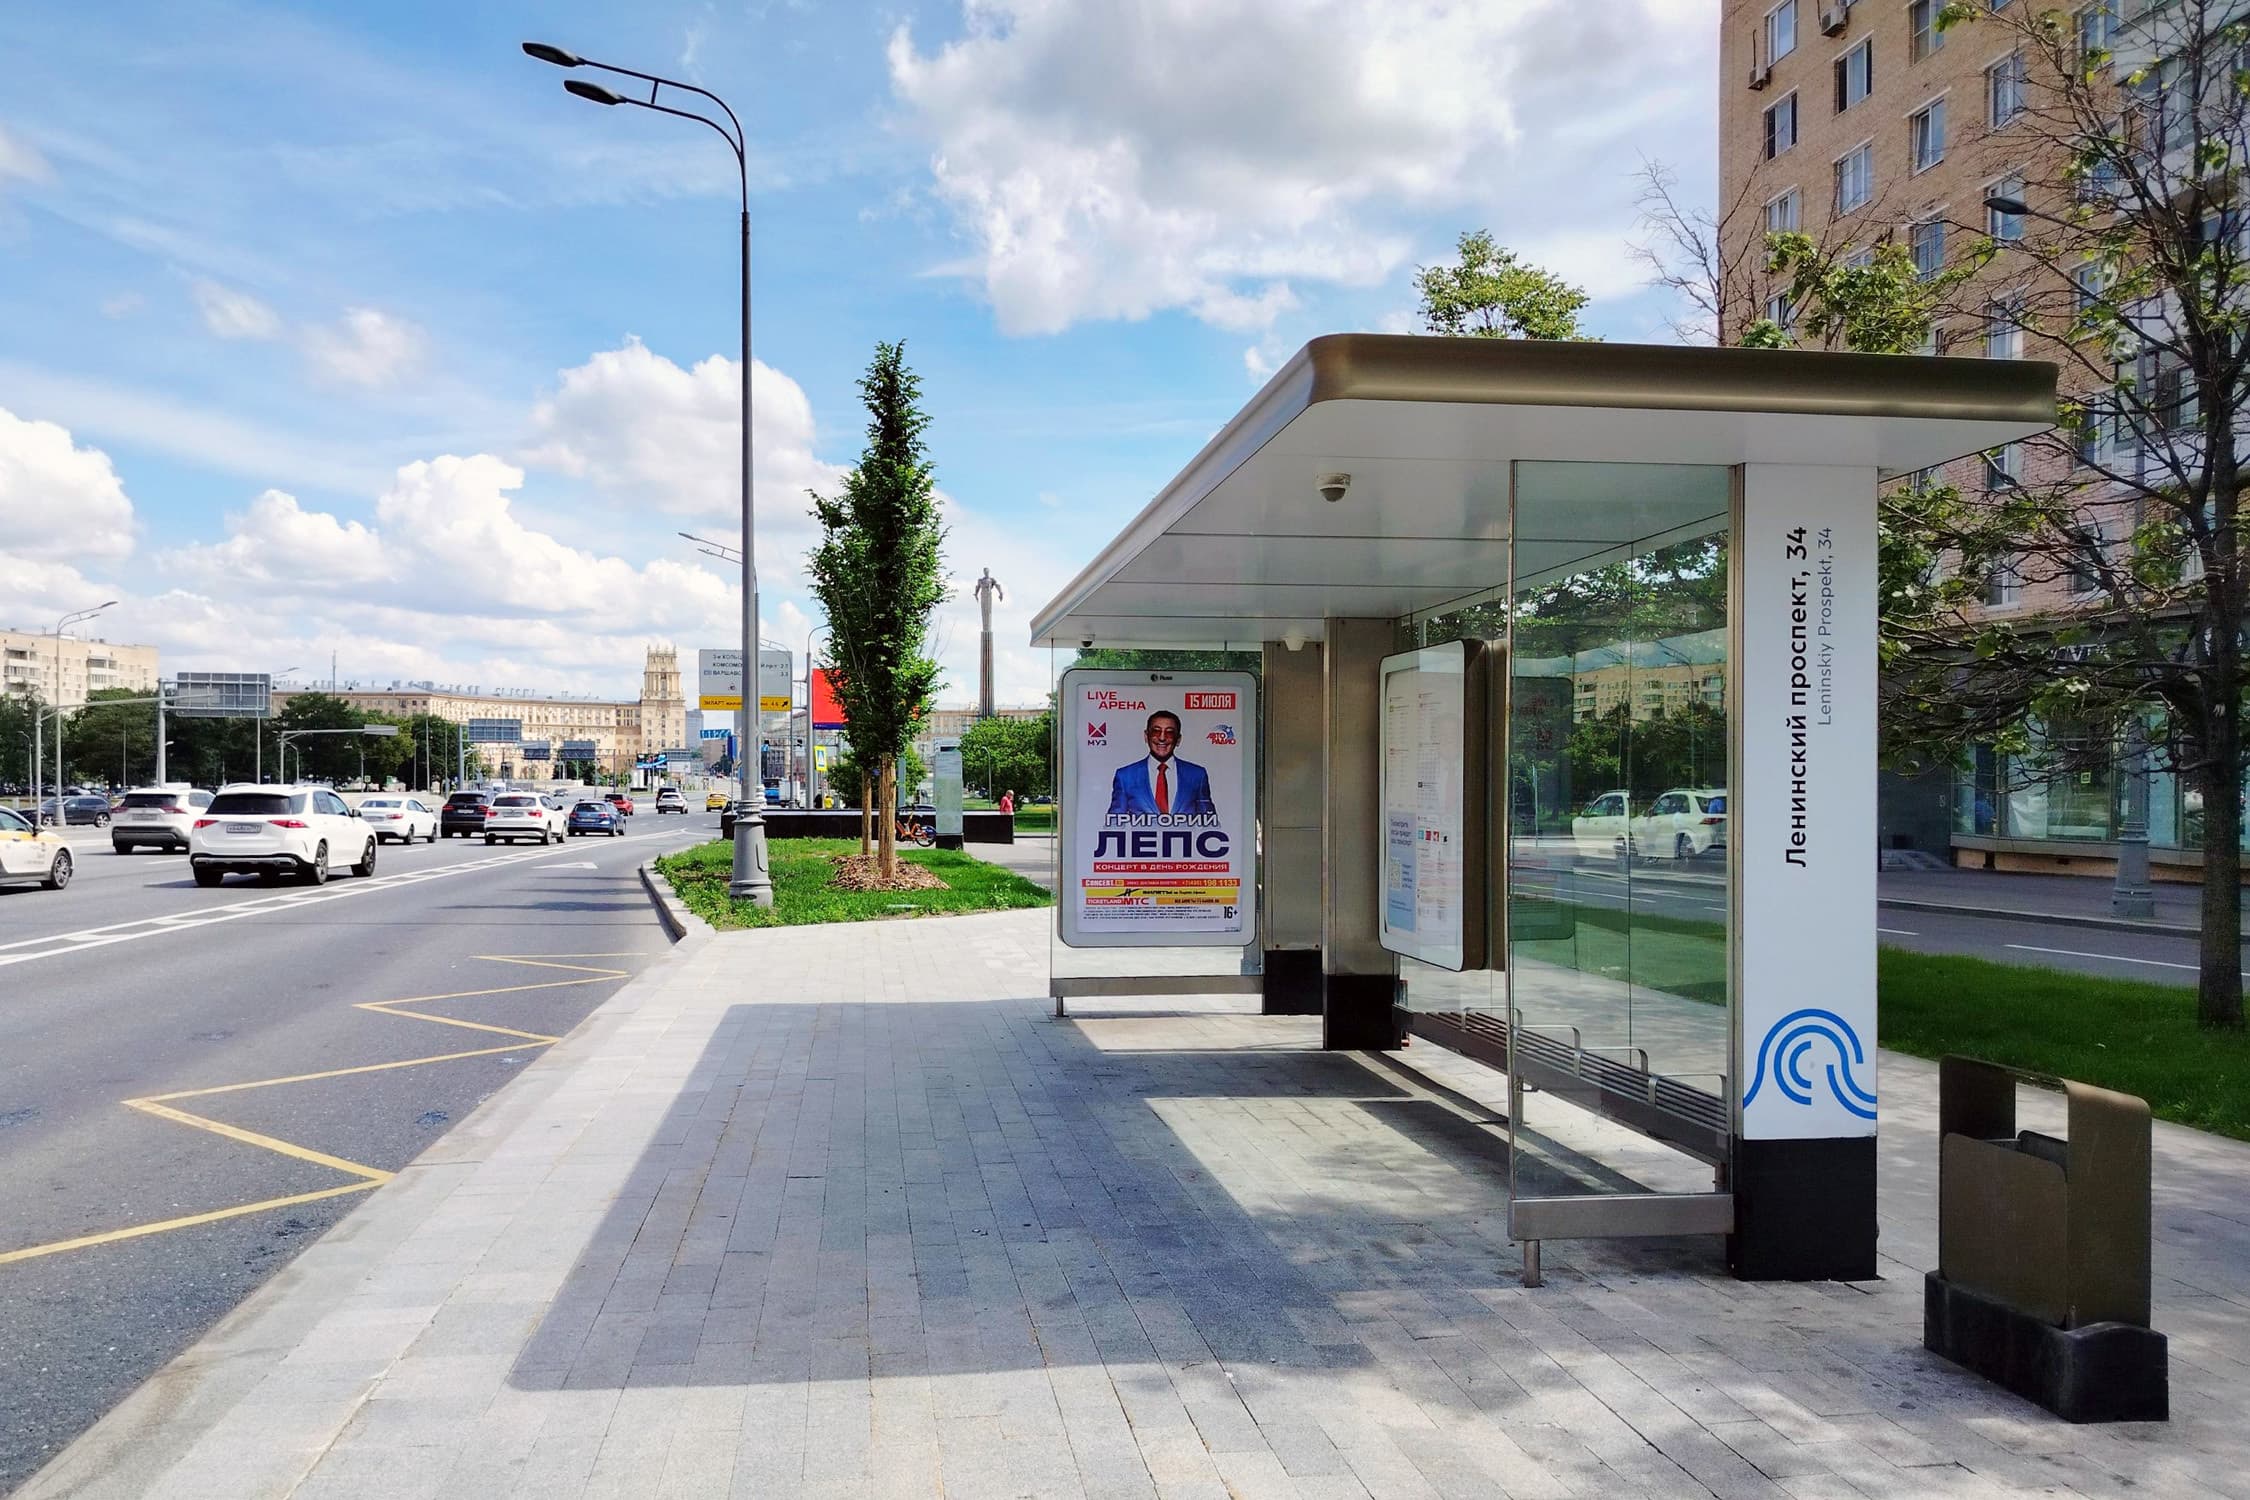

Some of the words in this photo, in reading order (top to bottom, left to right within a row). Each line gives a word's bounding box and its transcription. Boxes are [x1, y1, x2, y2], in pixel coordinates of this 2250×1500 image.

[1786, 526, 1807, 561] 34
[1817, 527, 1832, 549] 34
[1817, 554, 1834, 637] Prospekt,
[1790, 567, 1811, 706] проспект,
[1817, 643, 1834, 726] Leninskiy
[1087, 691, 1117, 700] LIVE
[1189, 694, 1200, 708] 15
[1201, 694, 1232, 708] ИЮЛЯ
[1098, 700, 1147, 710] АРЕНА
[1206, 732, 1226, 740] АВТО
[1211, 737, 1236, 745] РАДИО
[1785, 714, 1806, 868] Ленинский
[1106, 811, 1218, 826] ГРИГОРИЙ
[1093, 831, 1230, 858] ЛЕПС
[1223, 906, 1238, 919] 16+
